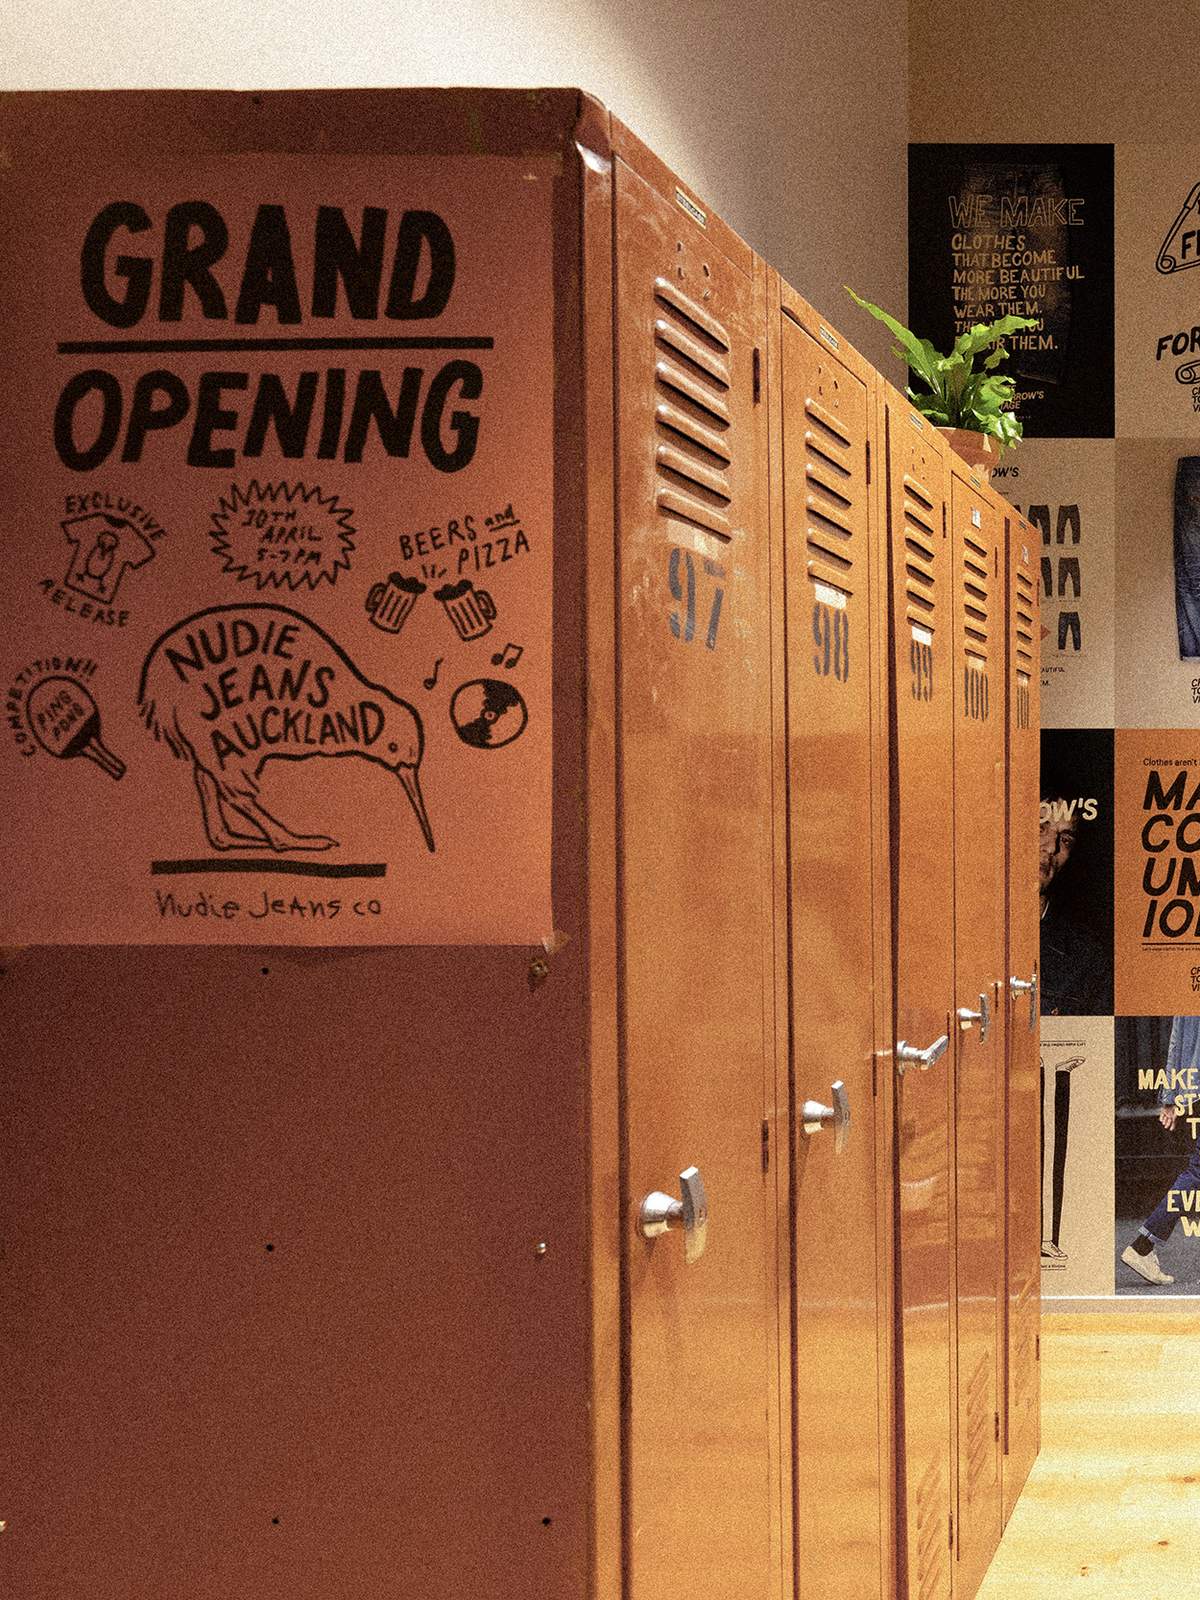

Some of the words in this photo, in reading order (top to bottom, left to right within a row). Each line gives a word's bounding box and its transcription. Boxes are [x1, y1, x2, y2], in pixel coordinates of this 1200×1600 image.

[948, 193, 993, 228] WE
[1000, 196, 1085, 227] MAKE
[81, 201, 456, 328] GRAND
[951, 233, 1026, 251] CLOTHES
[951, 252, 990, 268] THAT
[991, 249, 1057, 269] BECOME
[951, 286, 977, 301] THE
[979, 286, 1017, 301] MORE
[1020, 284, 1046, 299] YOU
[953, 269, 995, 285] MORE
[1000, 264, 1085, 284] BEAUTIFUL
[954, 304, 995, 319] WEAR
[998, 301, 1042, 316] THEM.
[954, 321, 975, 333] TH
[1009, 335, 1059, 350] THEM.
[53, 359, 483, 473] OPENING
[65, 491, 167, 541] EXCLUSIVE
[261, 526, 322, 543] APRIL
[399, 515, 476, 561] BEERS
[458, 529, 530, 575] PIZZA
[39, 579, 130, 627] RELEASE
[669, 547, 726, 651] 97
[164, 620, 299, 684] NUDIE
[812, 601, 848, 683] 98
[201, 660, 335, 721] JEANS
[911, 638, 933, 702] 99
[964, 664, 989, 722] 100
[210, 701, 385, 770] AUCKLAND
[1143, 758, 1173, 766] Clothes
[1138, 1068, 1198, 1090] MAKE
